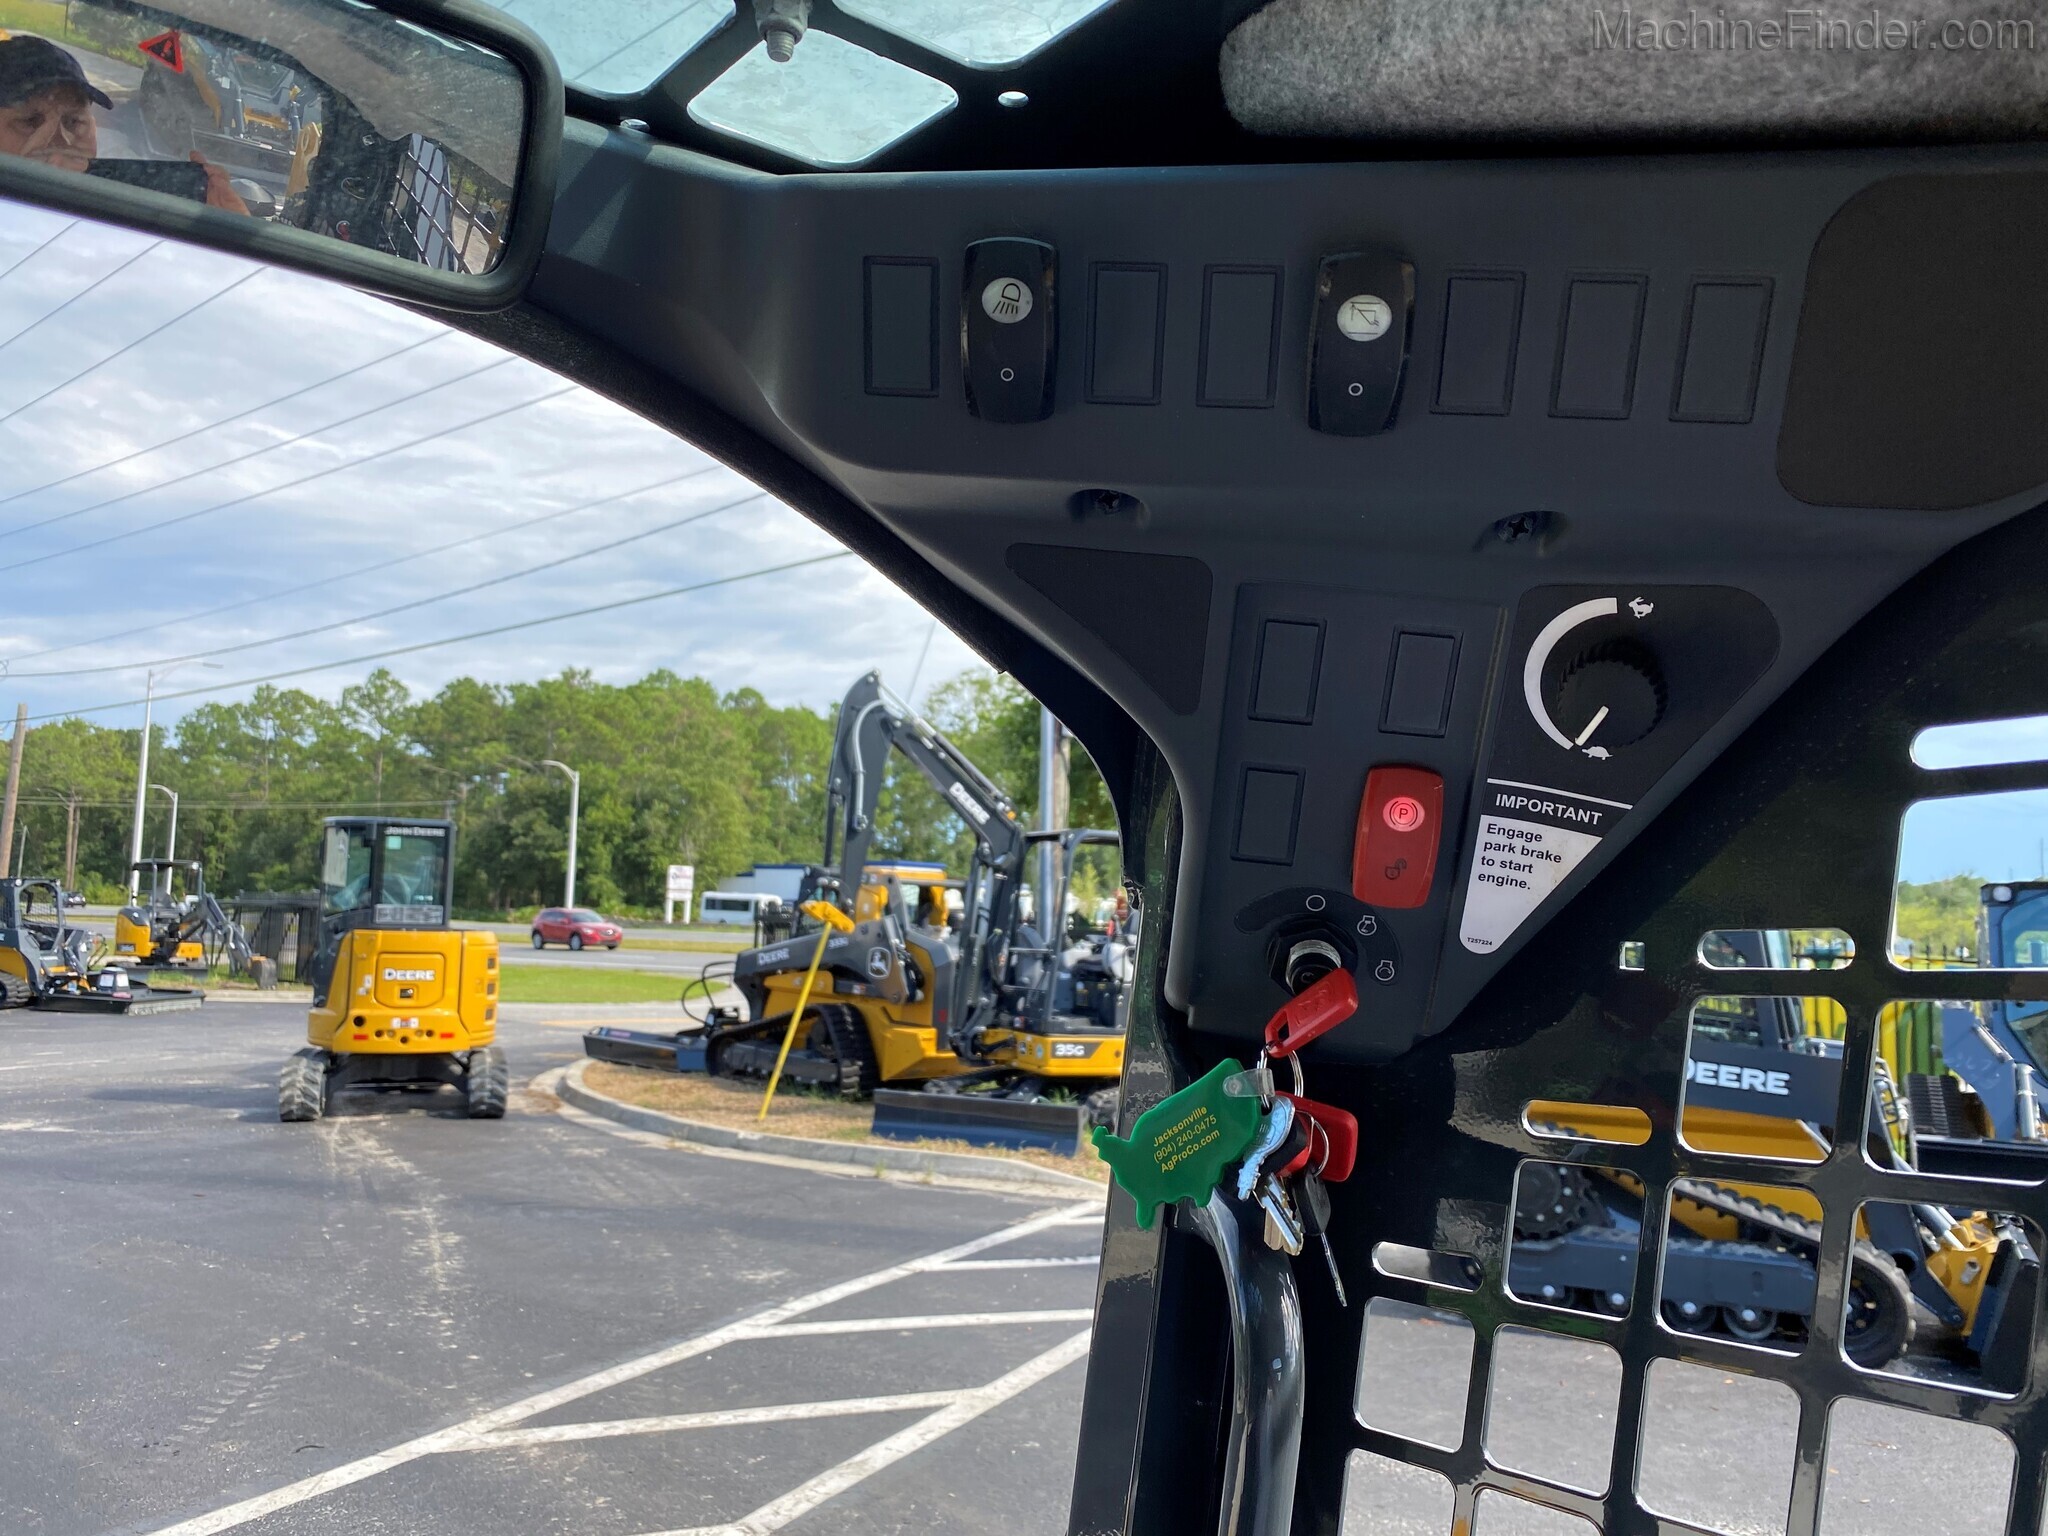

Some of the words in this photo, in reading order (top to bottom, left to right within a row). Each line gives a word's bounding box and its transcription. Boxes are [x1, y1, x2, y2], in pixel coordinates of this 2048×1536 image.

[949, 781, 990, 825] DEERE
[1495, 793, 1603, 826] IMPORTANT
[1486, 823, 1543, 843] Engage
[1483, 840, 1516, 854] park
[1520, 845, 1562, 863] brake
[1481, 856, 1496, 867] to
[1499, 859, 1534, 874] start
[1478, 873, 1532, 890] engine.
[1467, 937, 1493, 946] T257224
[758, 948, 790, 966] DEERE
[384, 968, 436, 981] DEERE
[1055, 1043, 1085, 1057] 35G
[1153, 1106, 1208, 1147] Jacksonville
[1153, 1141, 1177, 1164] (904)
[1176, 1114, 1217, 1147] 240-0475
[1161, 1129, 1220, 1173] AgProCo.com
